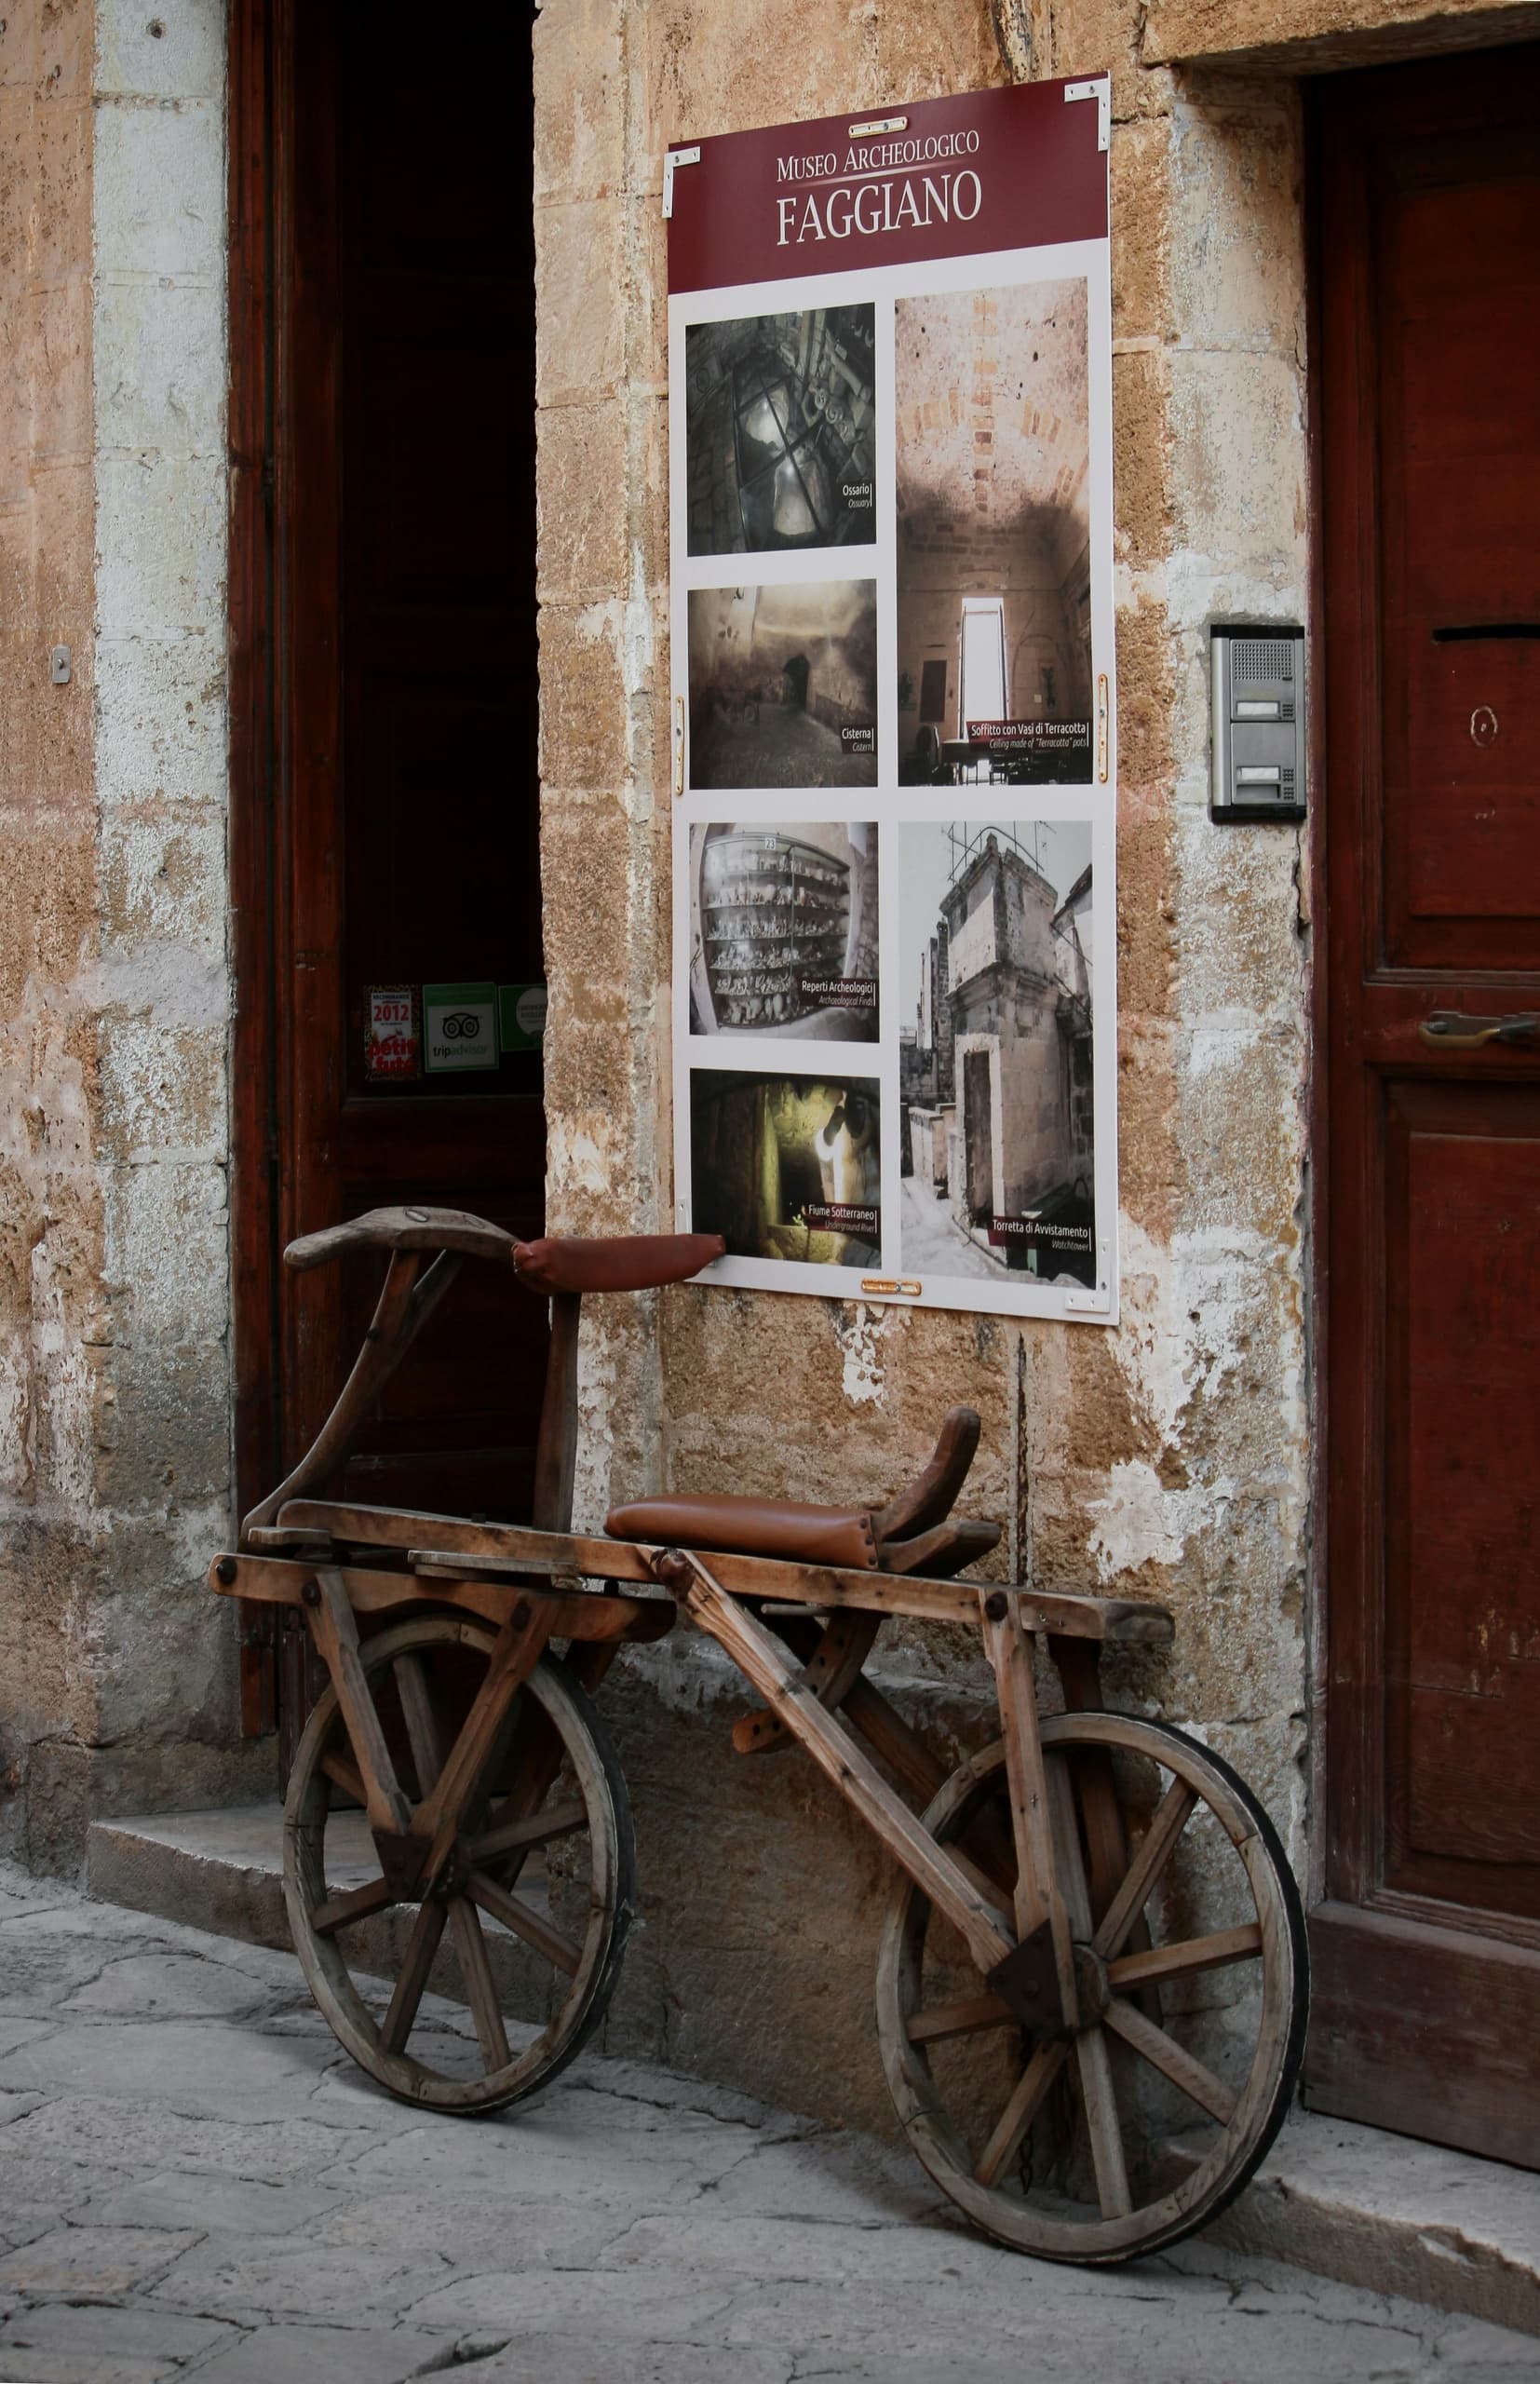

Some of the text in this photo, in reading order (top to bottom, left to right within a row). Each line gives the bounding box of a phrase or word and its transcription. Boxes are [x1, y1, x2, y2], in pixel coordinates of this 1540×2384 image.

[777, 130, 980, 183] MUSEO ARCHEOLOGICO
[777, 170, 982, 246] FAGGIANO
[843, 483, 870, 496] Ossario
[842, 727, 871, 739] Cisterna
[971, 722, 1087, 737] Soffitto con Vasi di Terracotta
[802, 980, 872, 996] Reperti Archeologici
[373, 1005, 410, 1022] 2012
[808, 1203, 874, 1221] Fiume Sotterraneo
[993, 1219, 1088, 1239] Torretta di Avvistamento
